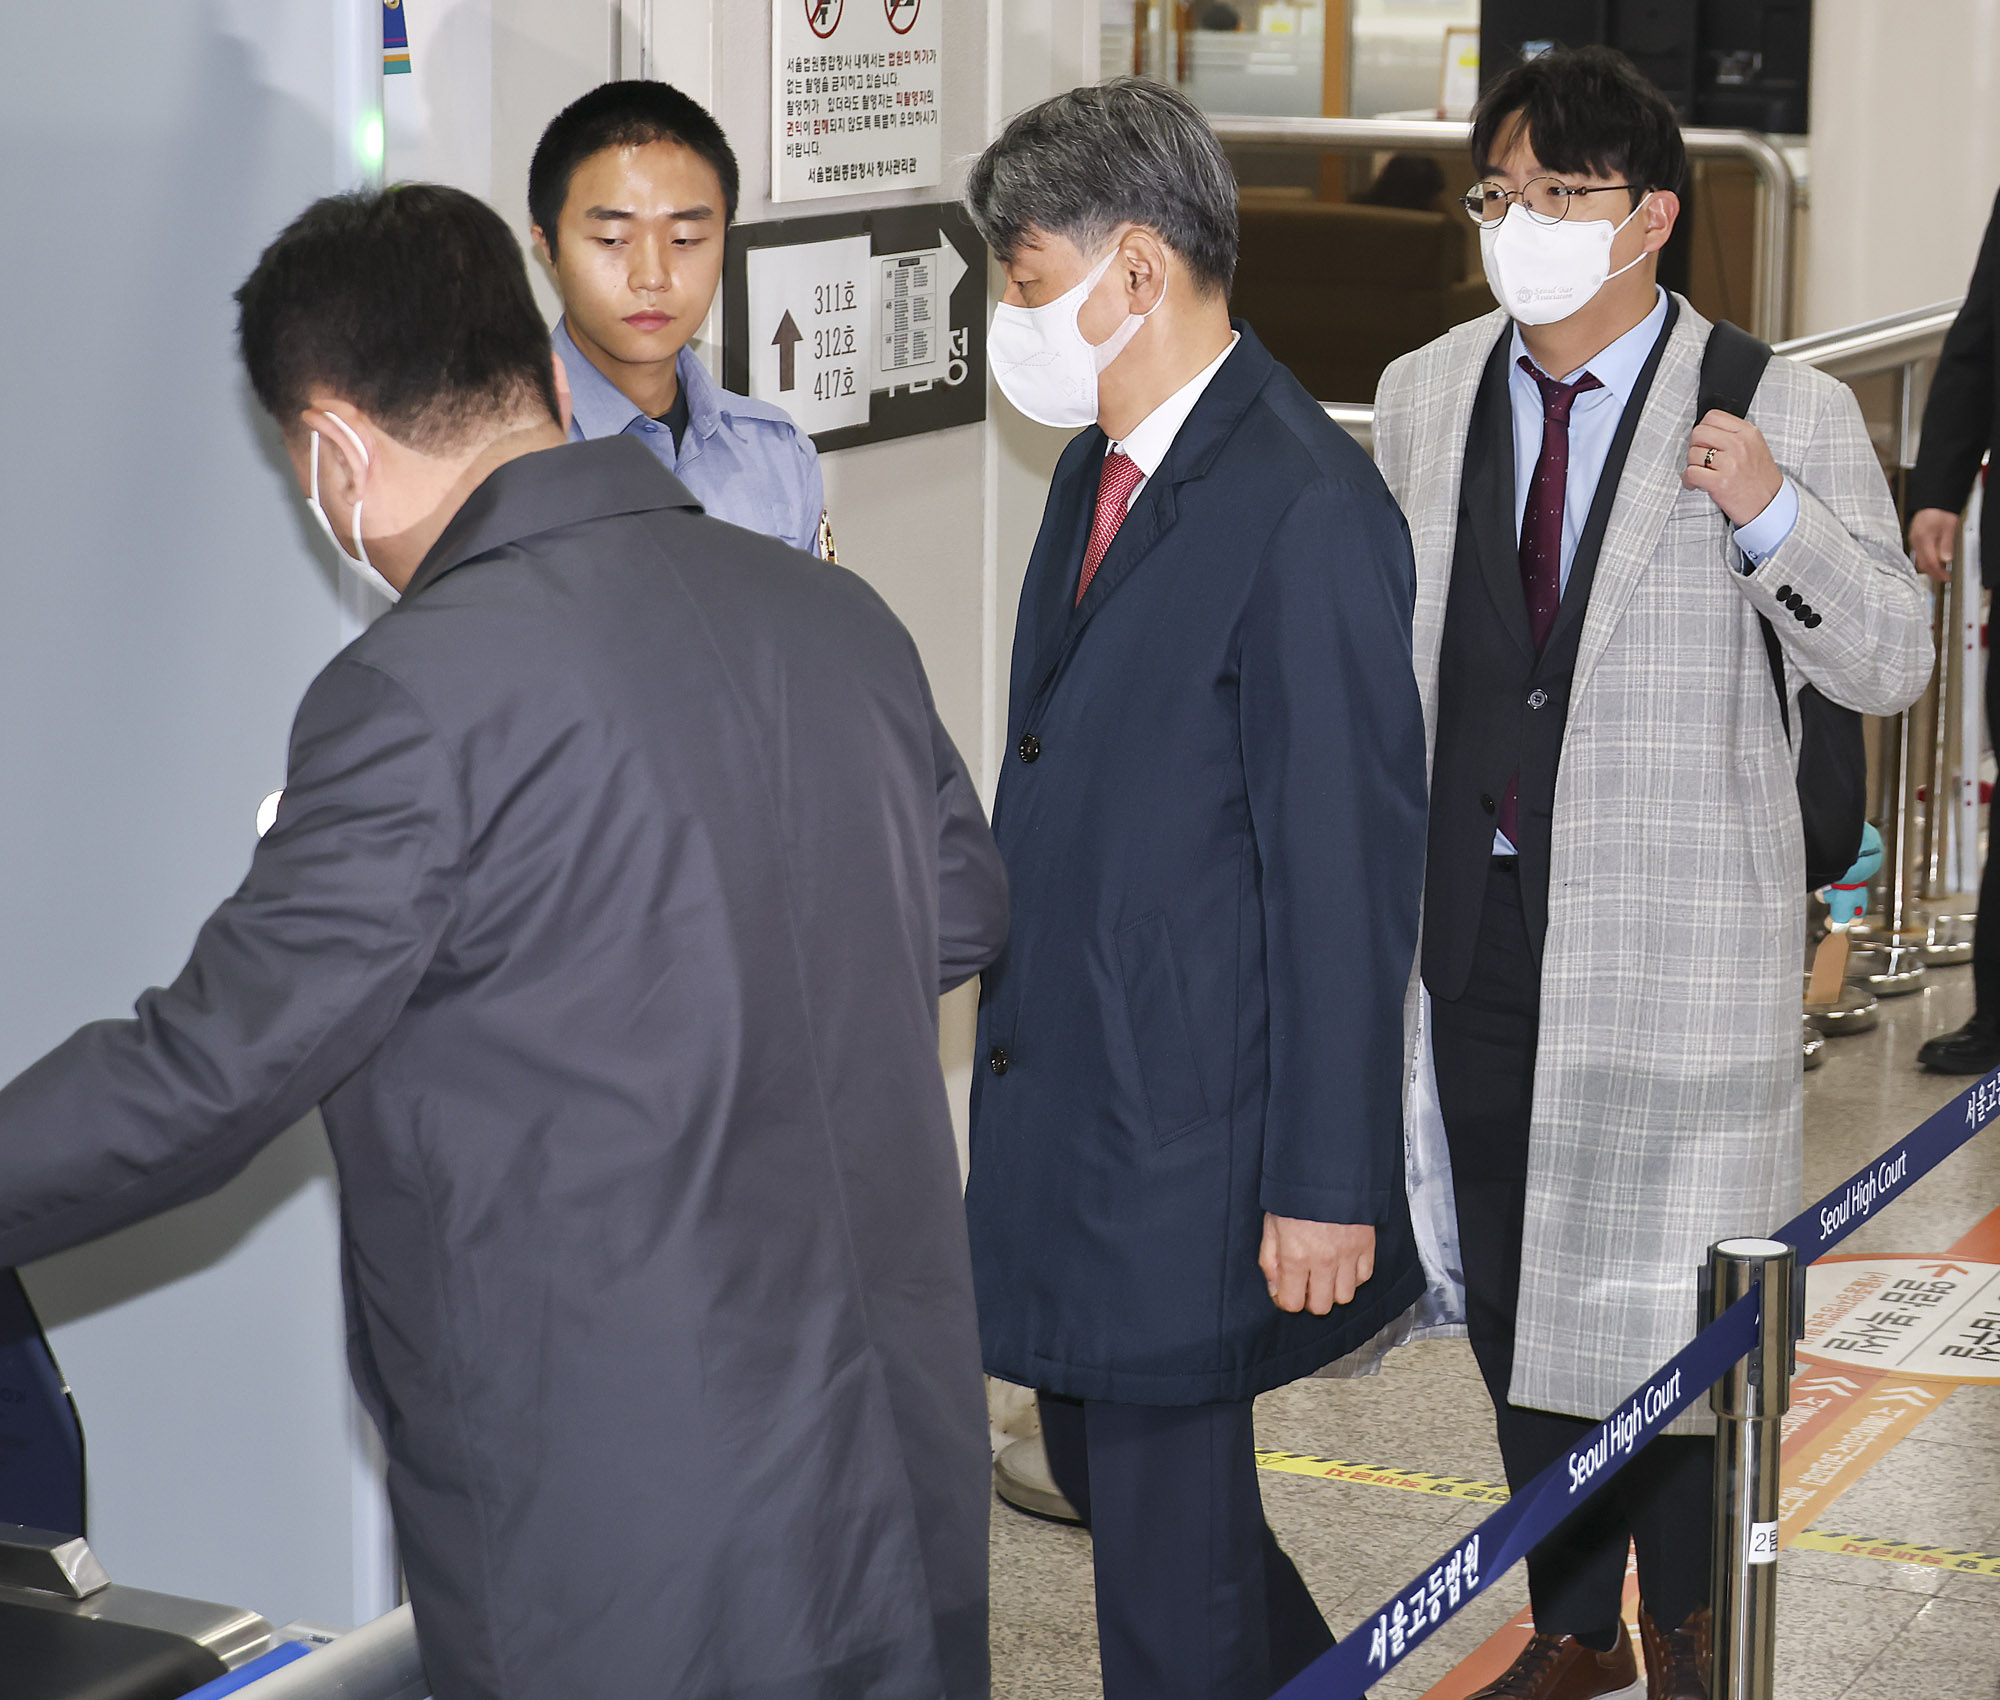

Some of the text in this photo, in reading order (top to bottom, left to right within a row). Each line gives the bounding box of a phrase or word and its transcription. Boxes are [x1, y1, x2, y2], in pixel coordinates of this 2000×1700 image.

[787, 49, 937, 72] 서울법원종합청사 내에서는 법원의 허가가
[787, 72, 900, 94] 없는 촬영을 금지하고 있습니다.
[787, 89, 934, 116] 촬영허가 있더라도 촬영자는 피촬영자의
[787, 109, 938, 137] 권익이 침해되지 않도록 특별히 유의하시기
[787, 141, 822, 158] 바랍니다.
[808, 157, 917, 184] 서울법원종합청사 청사관리관
[814, 281, 857, 315] 311호
[814, 325, 857, 359] 312호
[814, 367, 856, 401] 417호
[1965, 1072, 2000, 1129] 서울고
[1820, 1150, 1907, 1240] Seoul High Court
[1568, 1367, 1681, 1494] Seoul High Court
[1367, 1534, 1480, 1669] 서울고등법원
